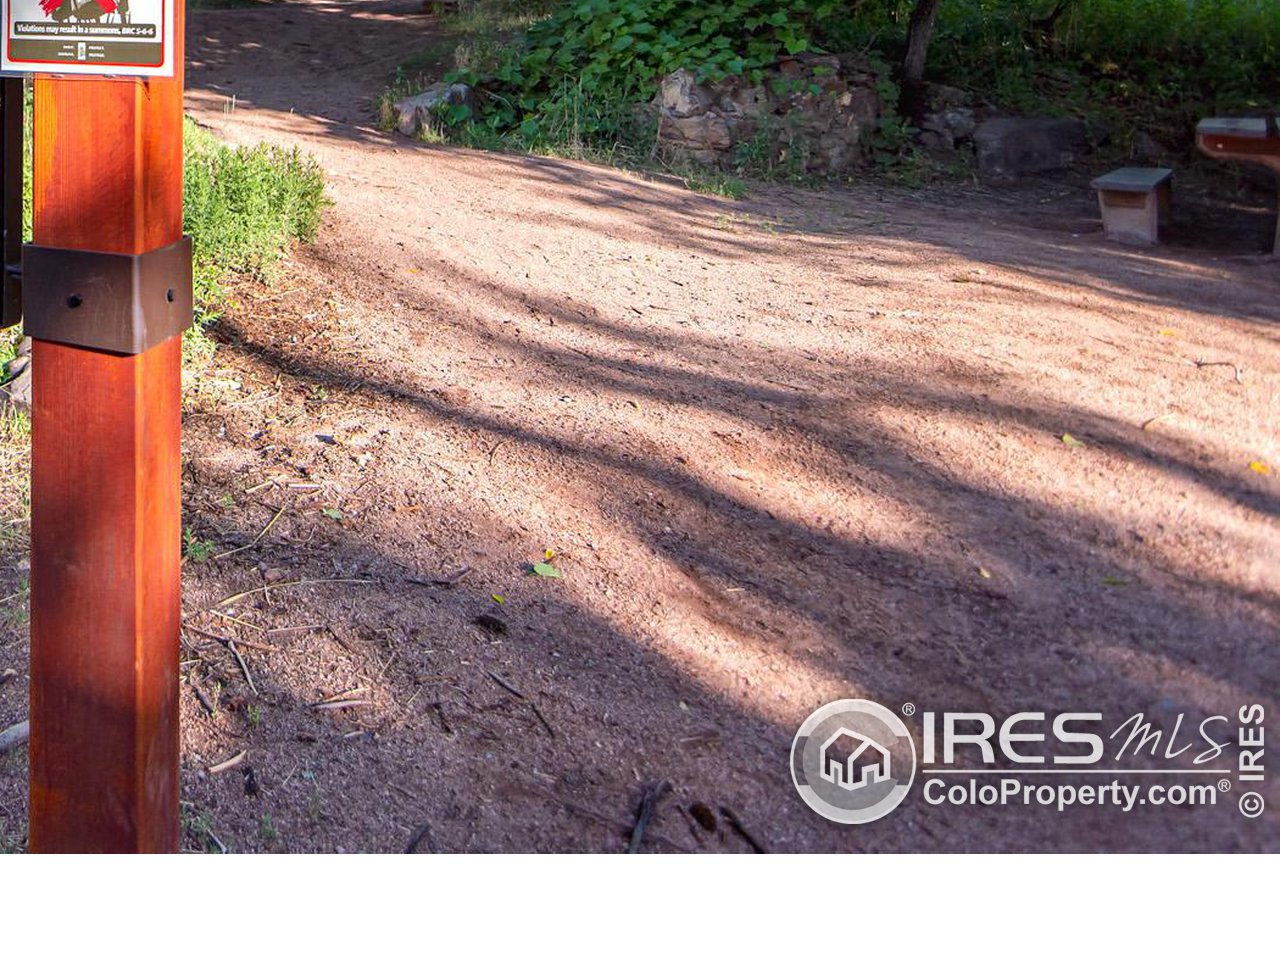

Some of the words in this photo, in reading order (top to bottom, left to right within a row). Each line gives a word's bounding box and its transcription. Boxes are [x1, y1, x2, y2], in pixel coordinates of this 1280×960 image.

[17, 24, 45, 33] Violations
[46, 26, 59, 35] may
[59, 25, 77, 33] result
[77, 25, 84, 33] in
